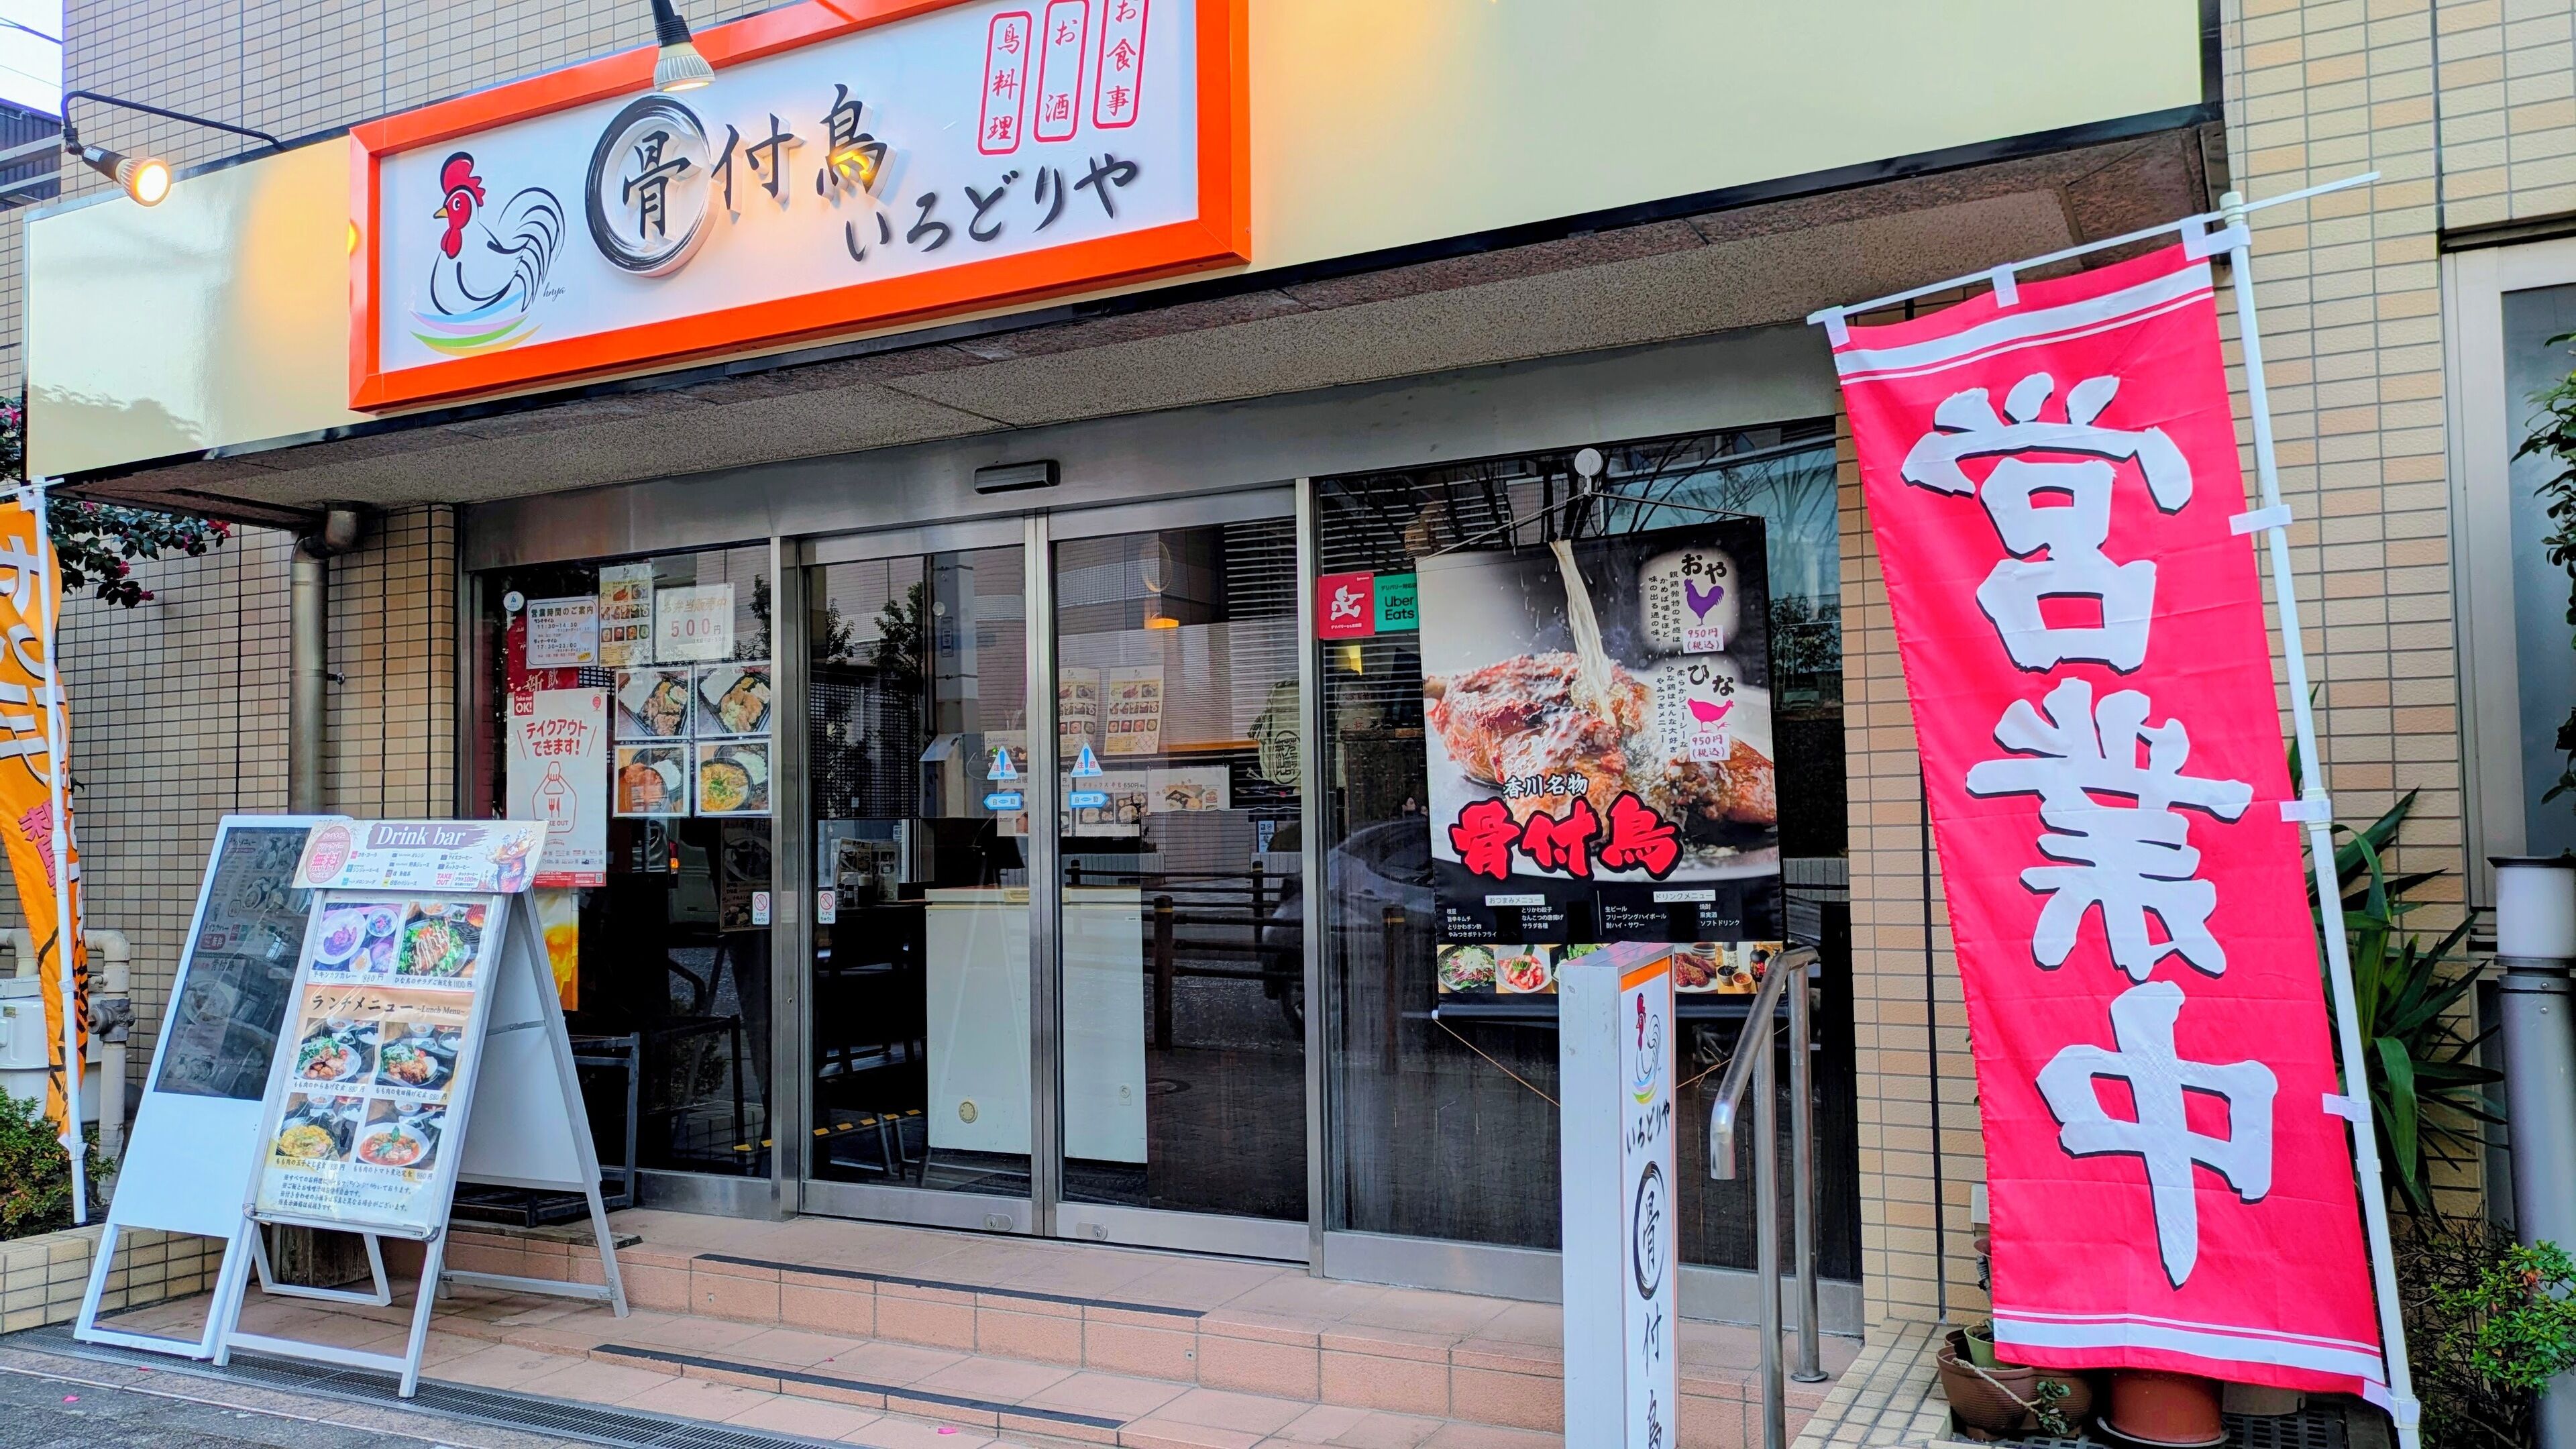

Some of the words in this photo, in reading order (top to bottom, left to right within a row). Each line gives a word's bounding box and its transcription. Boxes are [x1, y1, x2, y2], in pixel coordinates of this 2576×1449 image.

[1106, 0, 1136, 117] お食事
[986, 23, 1020, 140] 鳥料理
[1044, 19, 1078, 123] お酒
[621, 83, 887, 239] 骨付鳥
[845, 153, 1140, 262] いろどりや
[1681, 553, 1727, 584] おや
[531, 605, 594, 618] 営業時間のご案内
[1385, 595, 1414, 607] Uber
[1648, 576, 1660, 642] 味の出る通の味。
[1660, 578, 1670, 637] かめば噛むほど
[1385, 608, 1415, 621] Eats
[671, 618, 721, 638] 500円
[1687, 627, 1718, 638] 950円
[1687, 640, 1719, 651] (税込)
[1687, 665, 1735, 696] ひな
[515, 702, 533, 713] OK!
[1656, 678, 1667, 743] やみつきメニュー
[1666, 665, 1678, 753] ひな鶏はみんな大好き
[1677, 669, 1688, 747] 柔らかジューシーな
[526, 718, 588, 740] テイクアウト
[1692, 734, 1723, 745] 950円
[532, 738, 580, 757] できます!
[1693, 747, 1725, 759] (税込)
[994, 763, 1012, 771] 注意
[1077, 761, 1096, 769] 注意
[1503, 773, 1589, 798] 香川名物
[376, 826, 429, 845] Drink
[432, 826, 467, 845] bar
[1450, 792, 1680, 881] 骨付鳥
[1900, 372, 2281, 1290] 営業中
[310, 851, 341, 871] 無料
[313, 970, 357, 979] チキンカツカレー
[312, 995, 414, 1012] ランチメニュー
[294, 1081, 346, 1091] もも肉のからあげ定食
[1625, 1098, 1672, 1157] いろどりや
[1642, 1191, 1662, 1449] 骨付鳥
